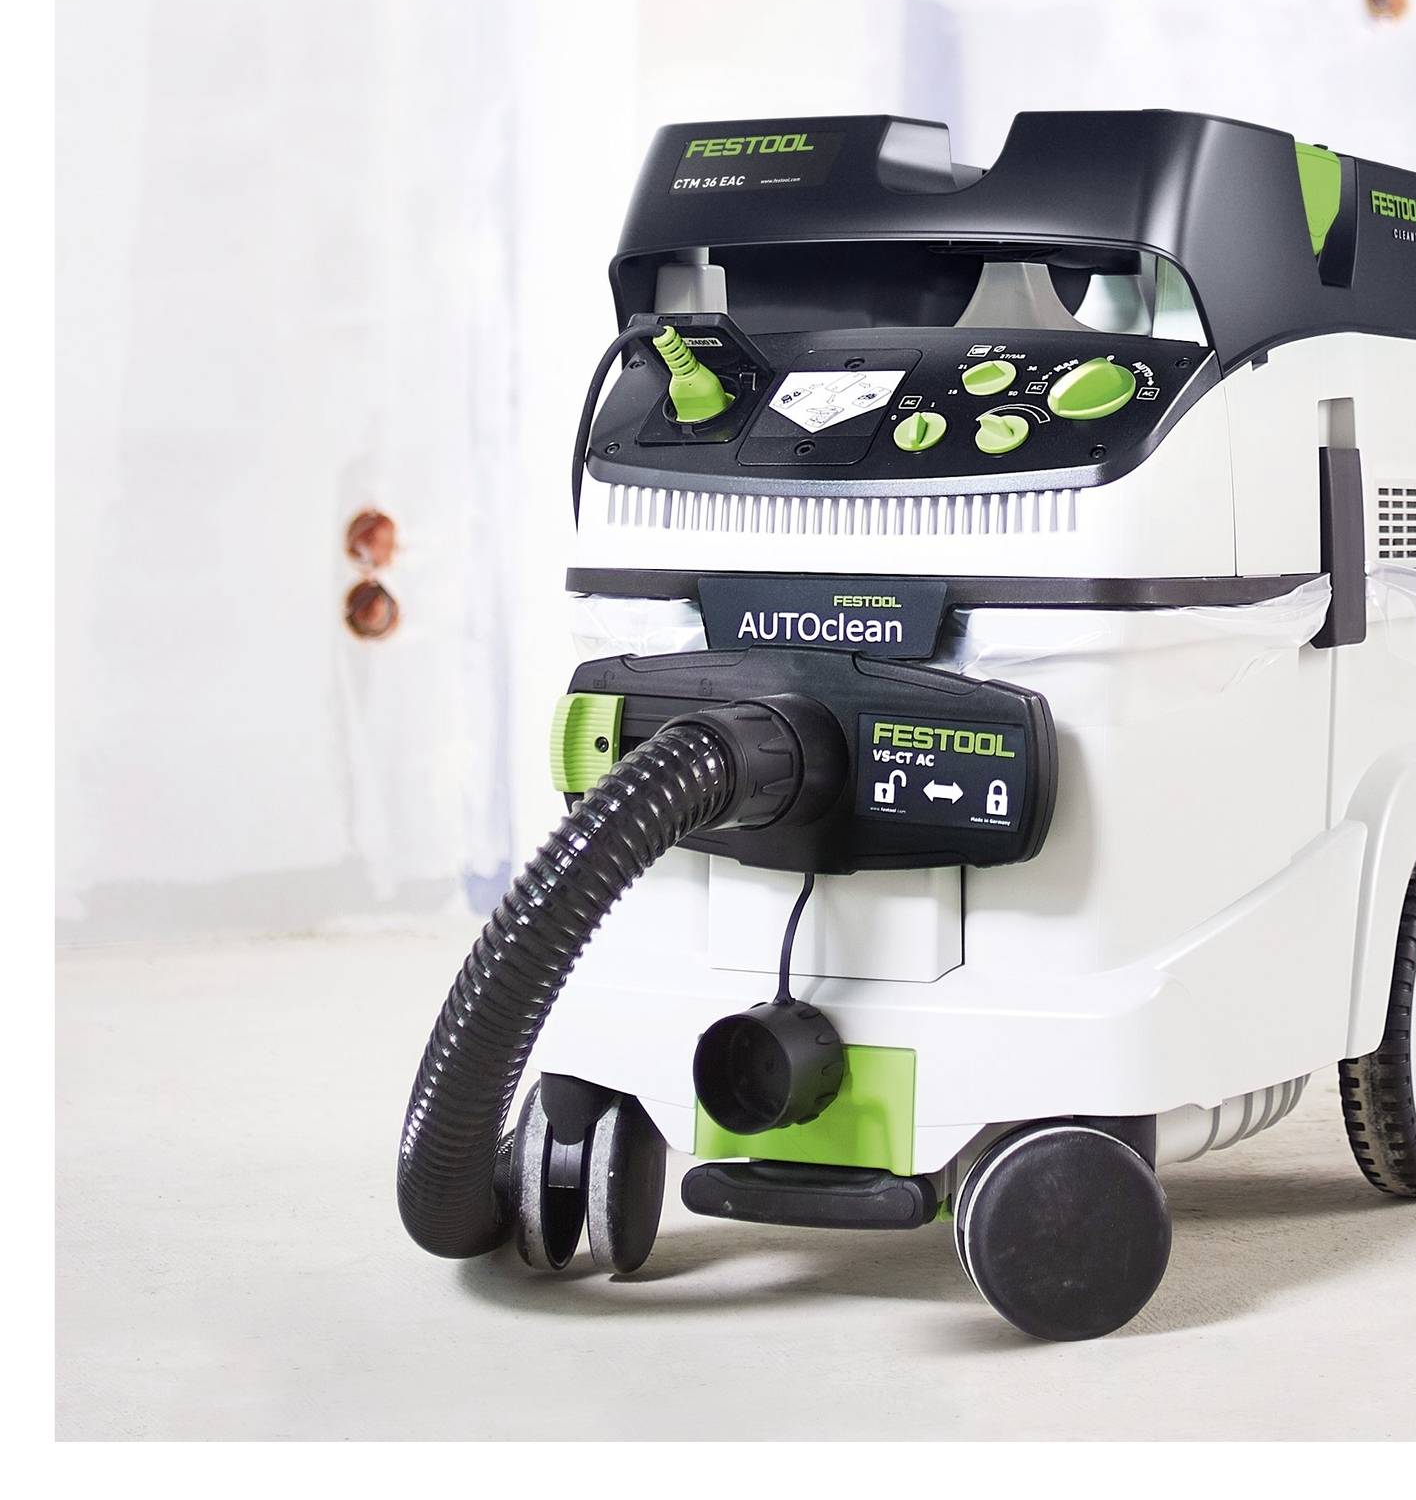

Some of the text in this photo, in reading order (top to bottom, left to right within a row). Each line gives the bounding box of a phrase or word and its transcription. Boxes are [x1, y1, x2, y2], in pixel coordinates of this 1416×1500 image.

[685, 133, 814, 158] FESTOOL
[673, 175, 746, 190] CTM 36 EAC
[833, 595, 902, 608] FESTOOL
[737, 611, 903, 643] AUTOclean
[872, 722, 1016, 758] FESTOOL
[872, 749, 935, 767] VS-CT AC
